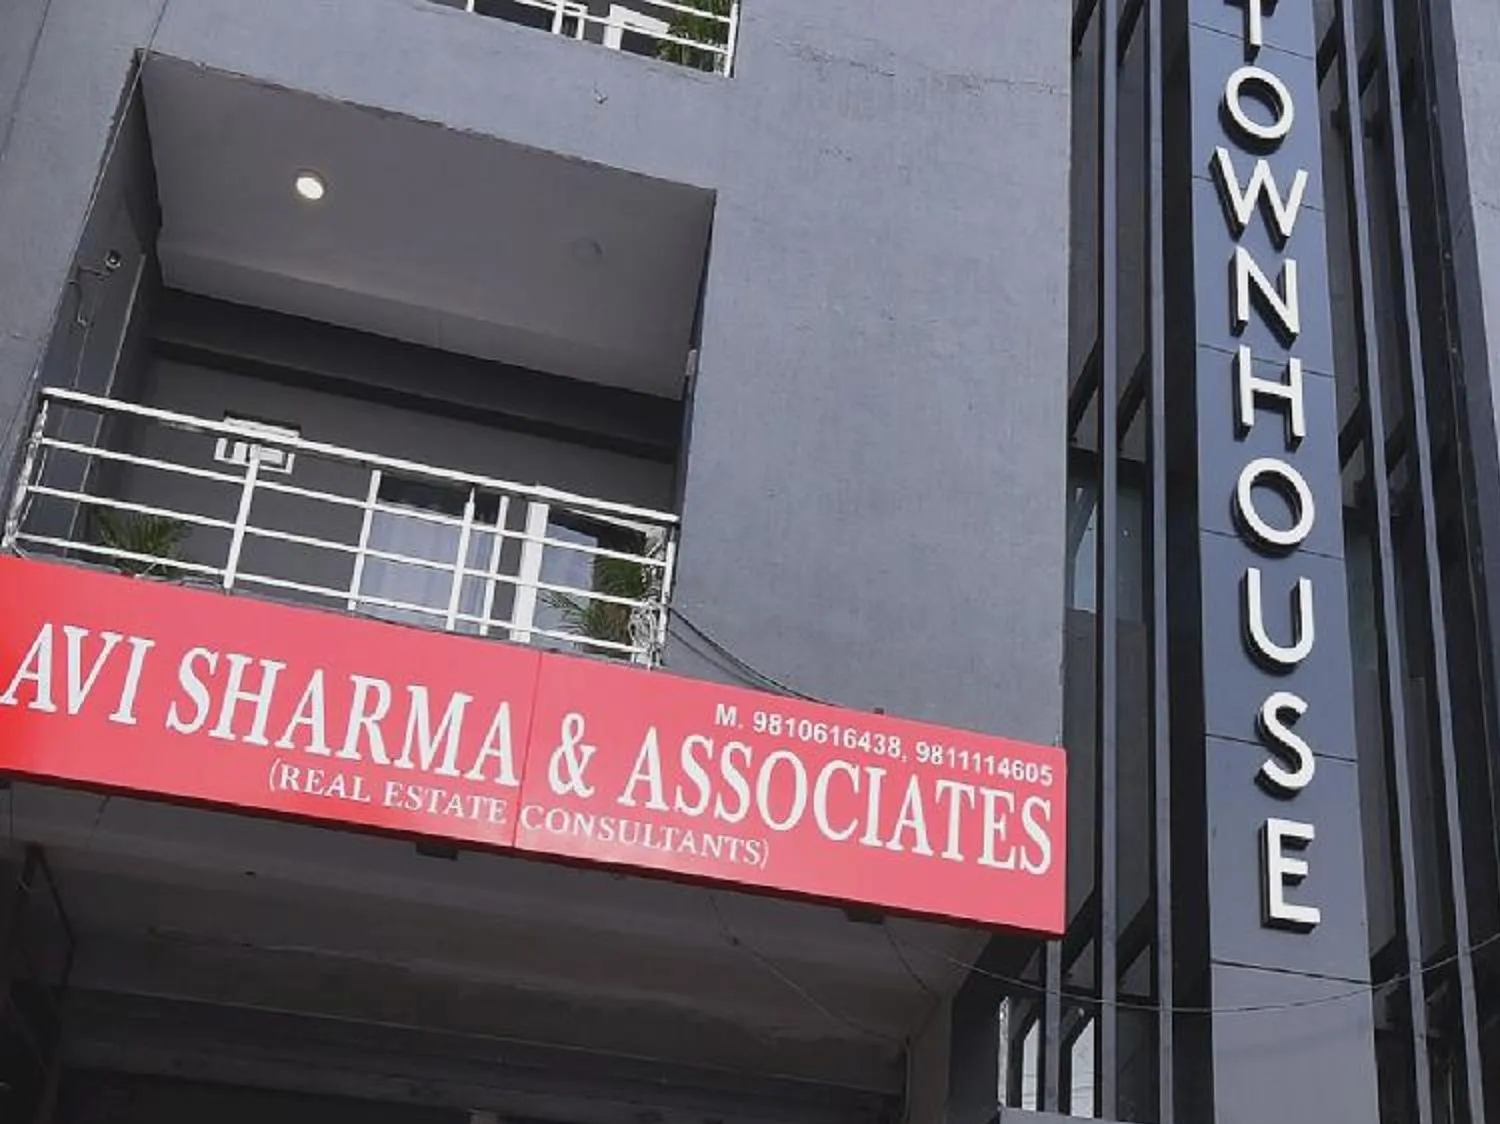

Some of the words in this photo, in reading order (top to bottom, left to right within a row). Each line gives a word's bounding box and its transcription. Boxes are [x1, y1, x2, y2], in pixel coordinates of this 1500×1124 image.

[1214, 0, 1321, 924] TOWNHOUSE
[0, 622, 155, 725] AVI
[166, 644, 521, 788] SHARMA
[547, 712, 597, 799] &
[618, 726, 1053, 876] ASSOCIATES
[268, 756, 371, 802] (REAL
[383, 779, 508, 825] ESTATE
[520, 804, 769, 869] CONSULTANTS)
[714, 703, 744, 730] M.
[753, 711, 908, 763] 9810616438,
[916, 741, 1055, 786] 9811114605
